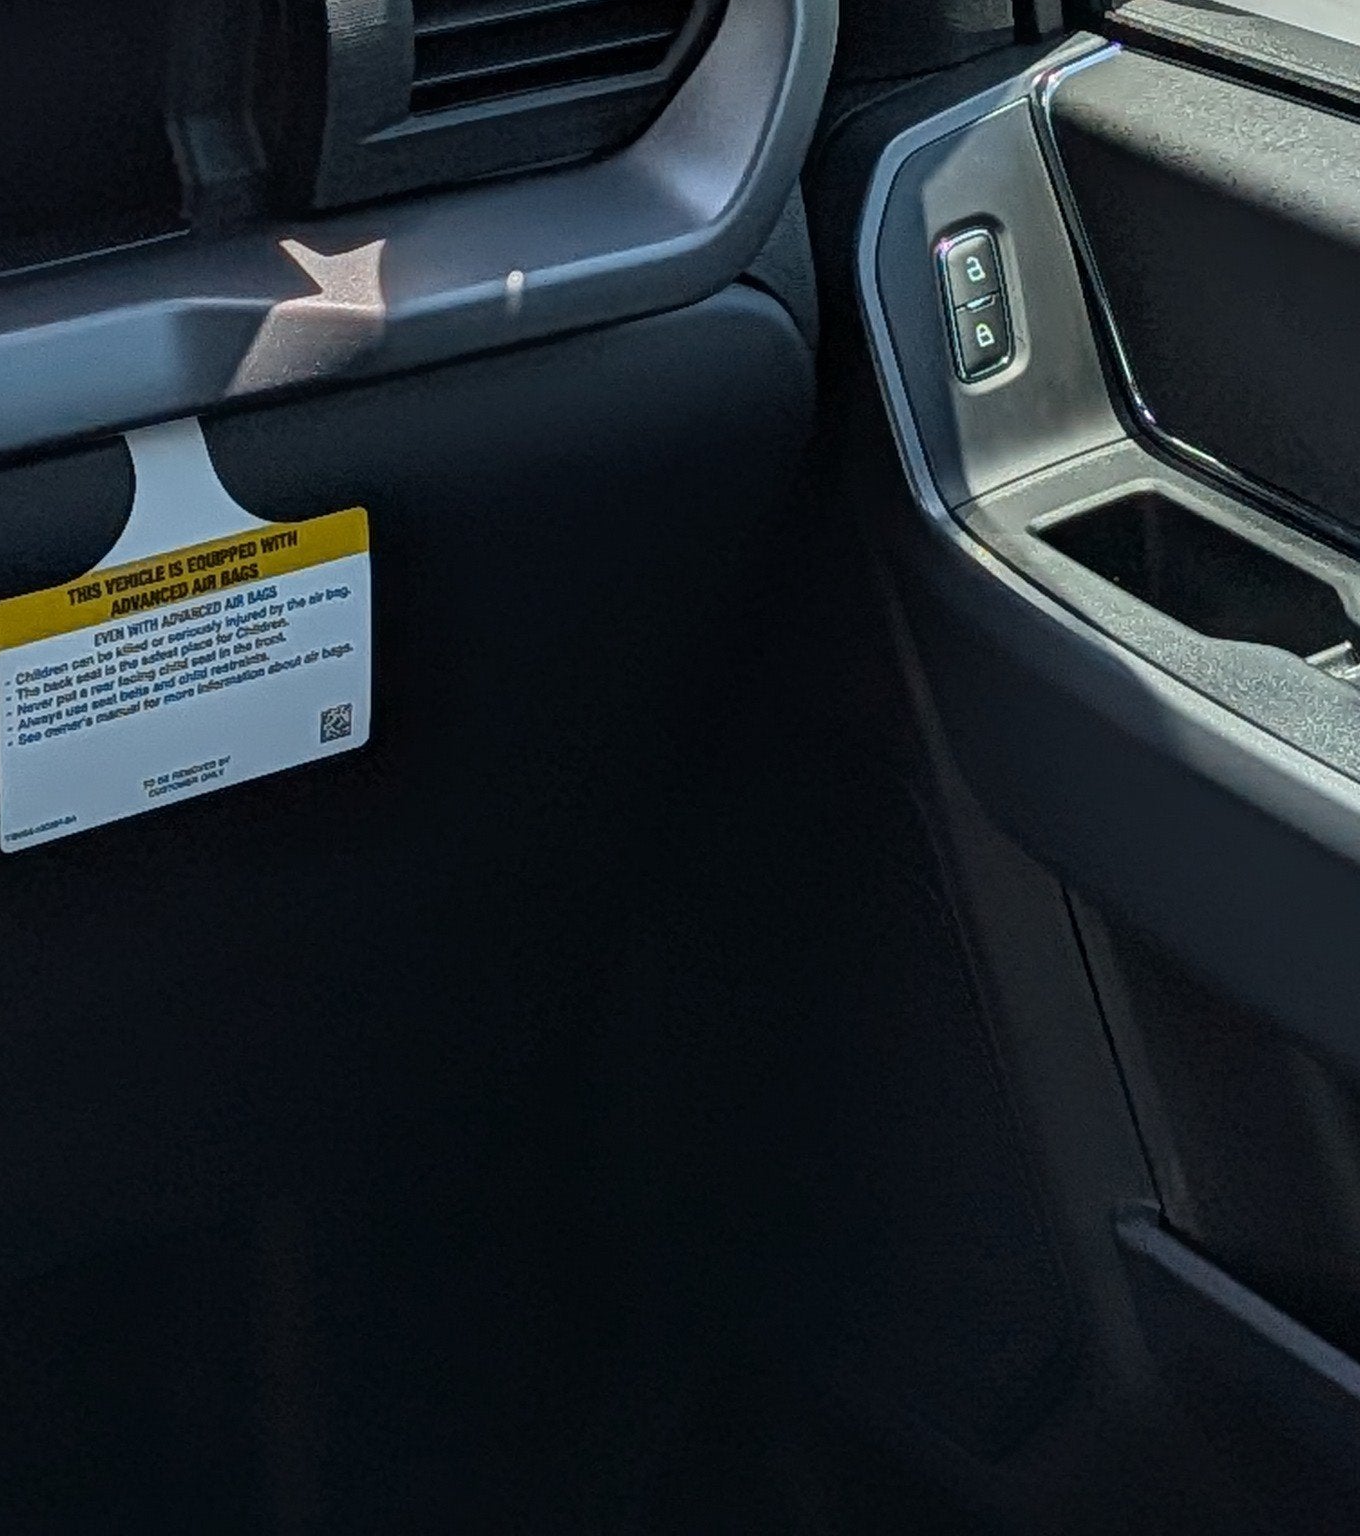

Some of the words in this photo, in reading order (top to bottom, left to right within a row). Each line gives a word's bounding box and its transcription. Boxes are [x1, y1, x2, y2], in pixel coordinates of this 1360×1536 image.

[68, 582, 101, 605] THIS
[104, 565, 165, 594] VEHICLE
[169, 559, 183, 578] IS
[187, 542, 257, 572] EQUIPPED
[261, 530, 297, 552] WITH
[111, 582, 188, 617] ADVANCED
[192, 576, 216, 594] AIR
[221, 564, 259, 585] BAGS
[16, 663, 68, 685] Children
[73, 657, 94, 670] can
[97, 651, 113, 663] be
[151, 637, 164, 647] or
[168, 620, 222, 644] seriously
[225, 607, 266, 627] injured
[270, 605, 284, 616] by
[287, 598, 305, 610] the
[309, 592, 324, 604] air
[95, 628, 124, 647] EVEN
[127, 618, 158, 639] WITH
[161, 601, 222, 629] ADVANCED
[225, 594, 244, 611] AIR
[248, 586, 277, 605] BAGS
[16, 688, 40, 700] The
[44, 678, 72, 693] back
[76, 668, 102, 684] seat
[105, 663, 116, 675] is
[119, 658, 138, 672] the
[181, 638, 212, 658] place
[217, 632, 233, 646] for
[17, 700, 53, 716] Never
[57, 689, 77, 707] put
[80, 688, 87, 697] a
[91, 682, 114, 696] rear
[118, 671, 155, 687] facing
[159, 658, 188, 675] child
[192, 649, 216, 666] seat
[219, 647, 230, 658] in
[234, 642, 252, 654] the
[18, 712, 62, 730] Always
[65, 704, 87, 717] use
[92, 695, 118, 710] seat
[120, 685, 149, 701] belts
[153, 678, 175, 694] and
[179, 667, 207, 685] child
[18, 730, 41, 745] See
[44, 717, 92, 739] owner's
[96, 704, 140, 723] manual
[143, 697, 161, 710] for
[164, 686, 195, 705] more
[198, 667, 265, 693] information
[268, 656, 301, 675] about
[304, 652, 319, 663] air
